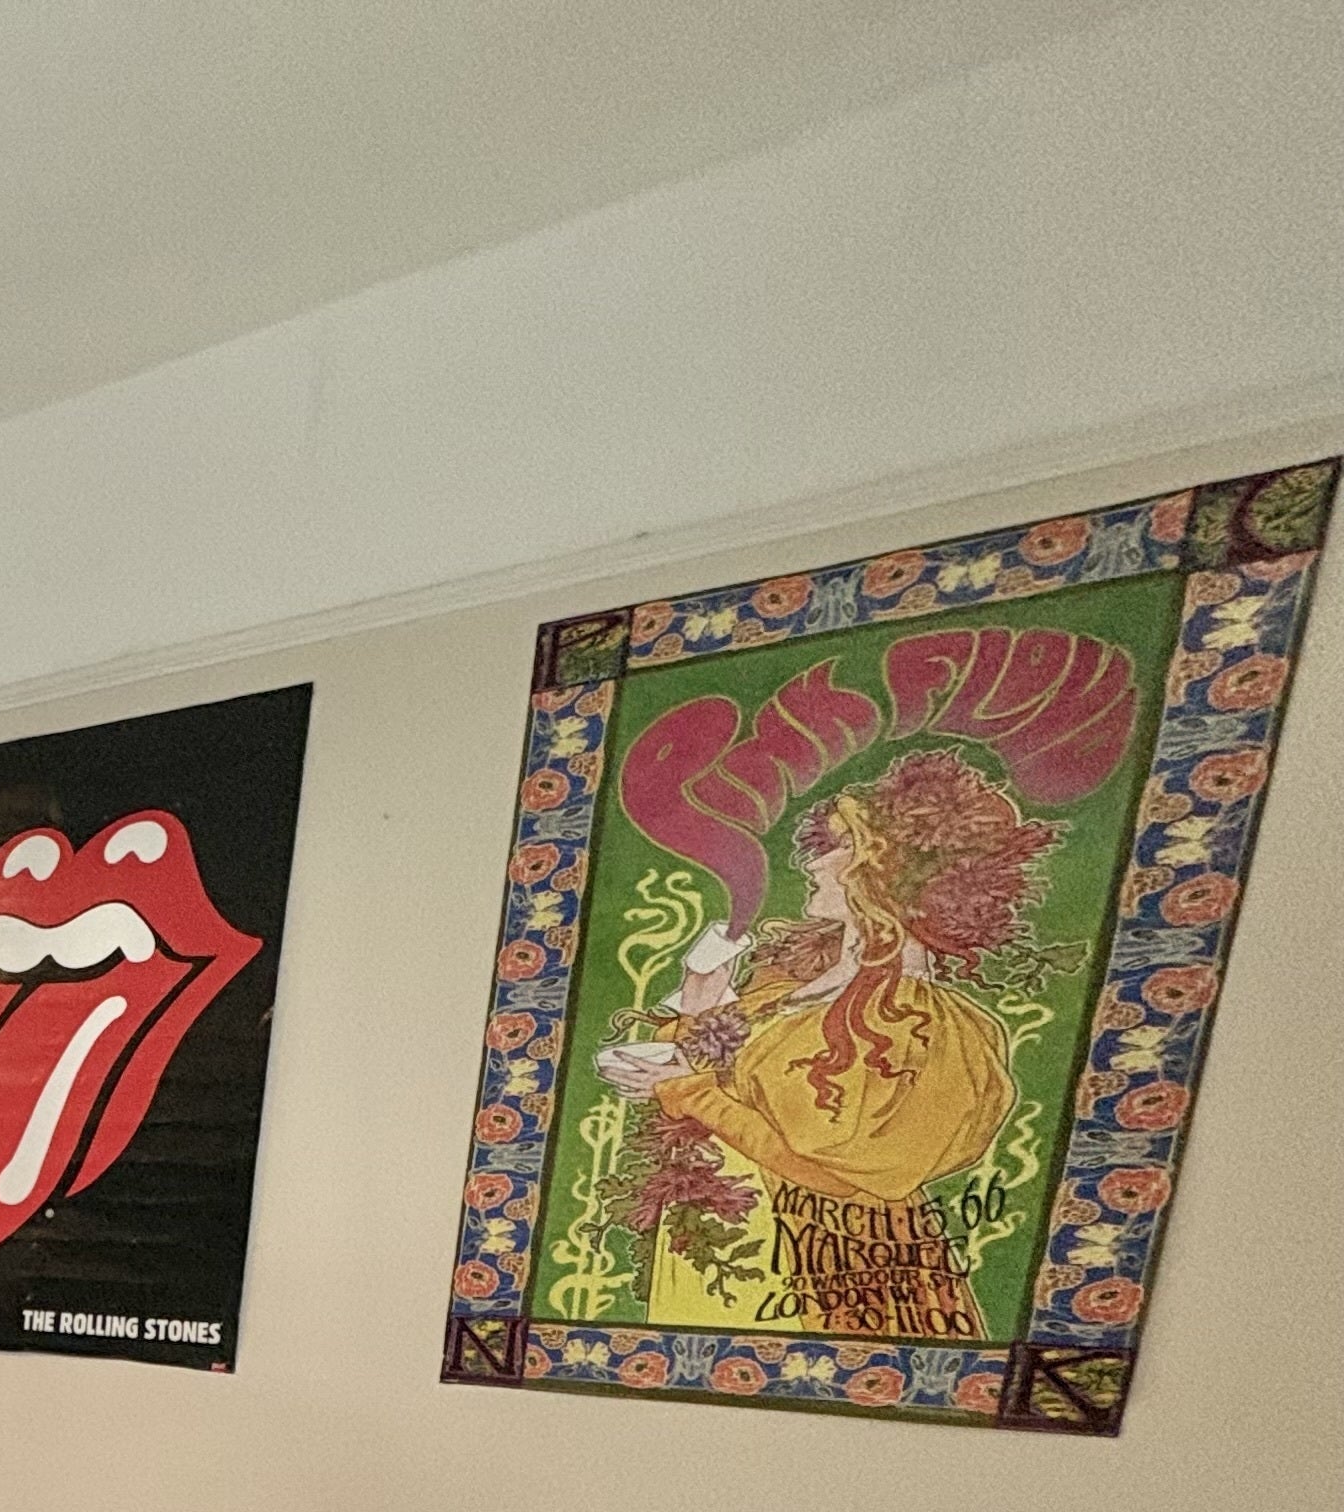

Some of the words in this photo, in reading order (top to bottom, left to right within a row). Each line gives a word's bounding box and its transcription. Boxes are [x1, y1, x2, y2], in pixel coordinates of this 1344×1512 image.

[772, 1181, 897, 1242] MARCH
[962, 1170, 1005, 1230] 66
[771, 1217, 971, 1278] MARQUEE
[782, 1276, 806, 1292] 90
[812, 1269, 921, 1292] WARDOUR
[928, 1273, 961, 1299] ST
[755, 1286, 884, 1322] LONDON
[22, 1310, 55, 1332] THE
[59, 1312, 139, 1339] ROLLING
[144, 1318, 221, 1344] STONES
